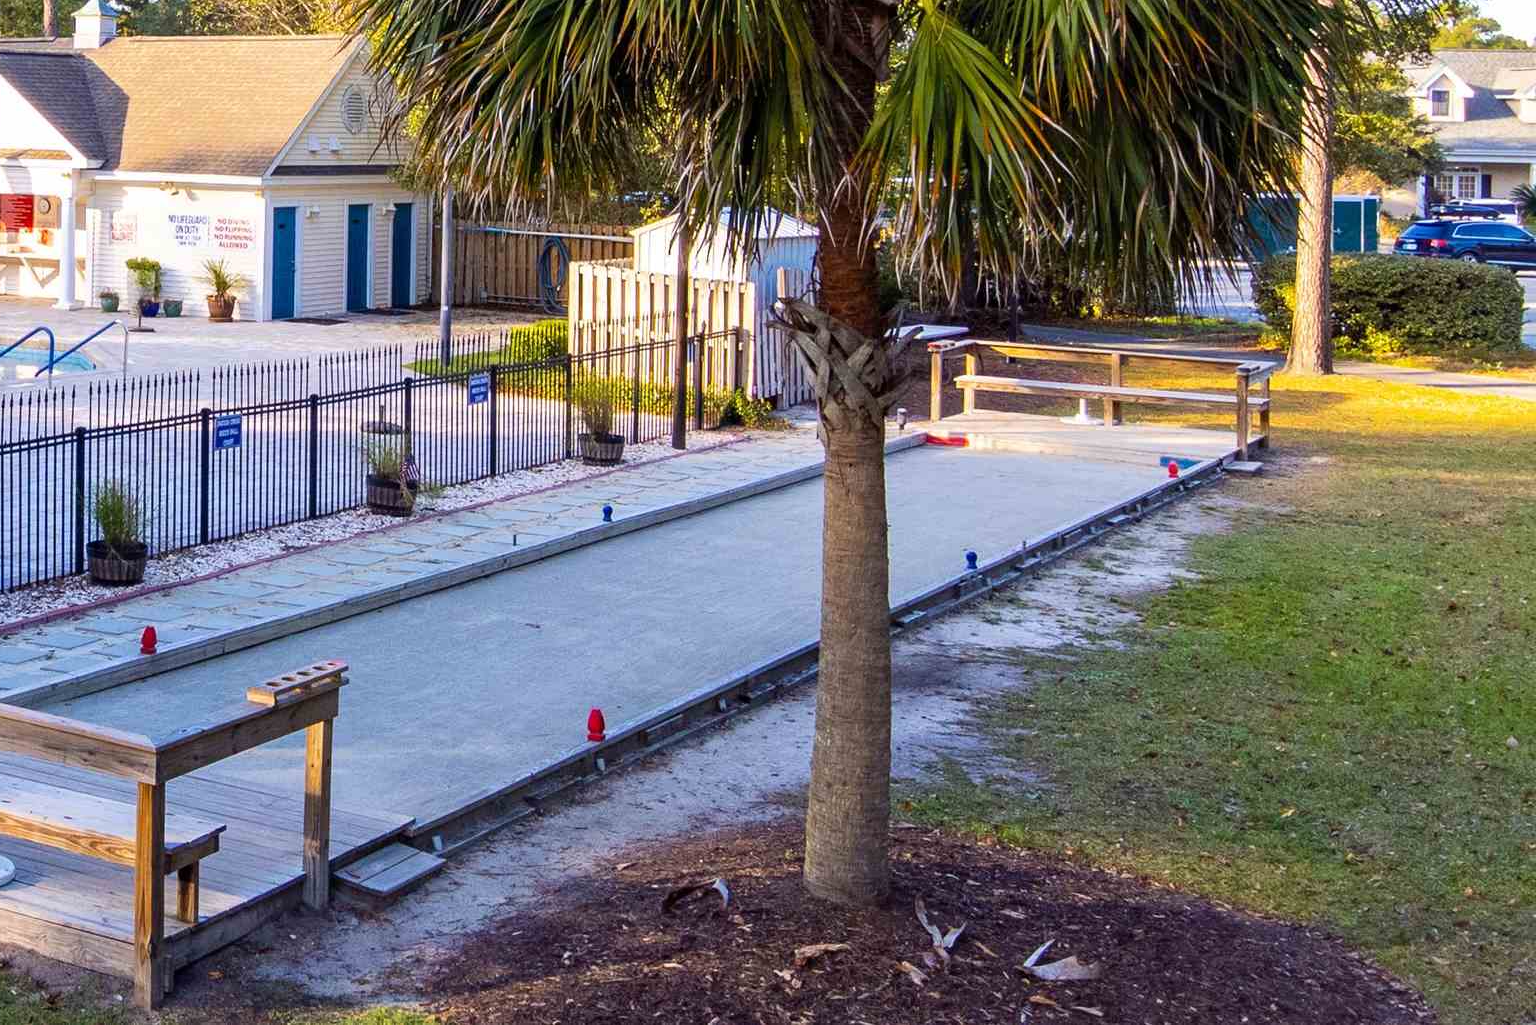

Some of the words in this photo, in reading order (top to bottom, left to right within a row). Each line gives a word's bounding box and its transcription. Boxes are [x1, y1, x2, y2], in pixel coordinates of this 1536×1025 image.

[168, 215, 176, 224] NO
[176, 215, 207, 224] LIFEGUARD
[175, 225, 183, 234] ON
[184, 225, 199, 234] DUTY
[218, 241, 248, 249] ALLOWED
